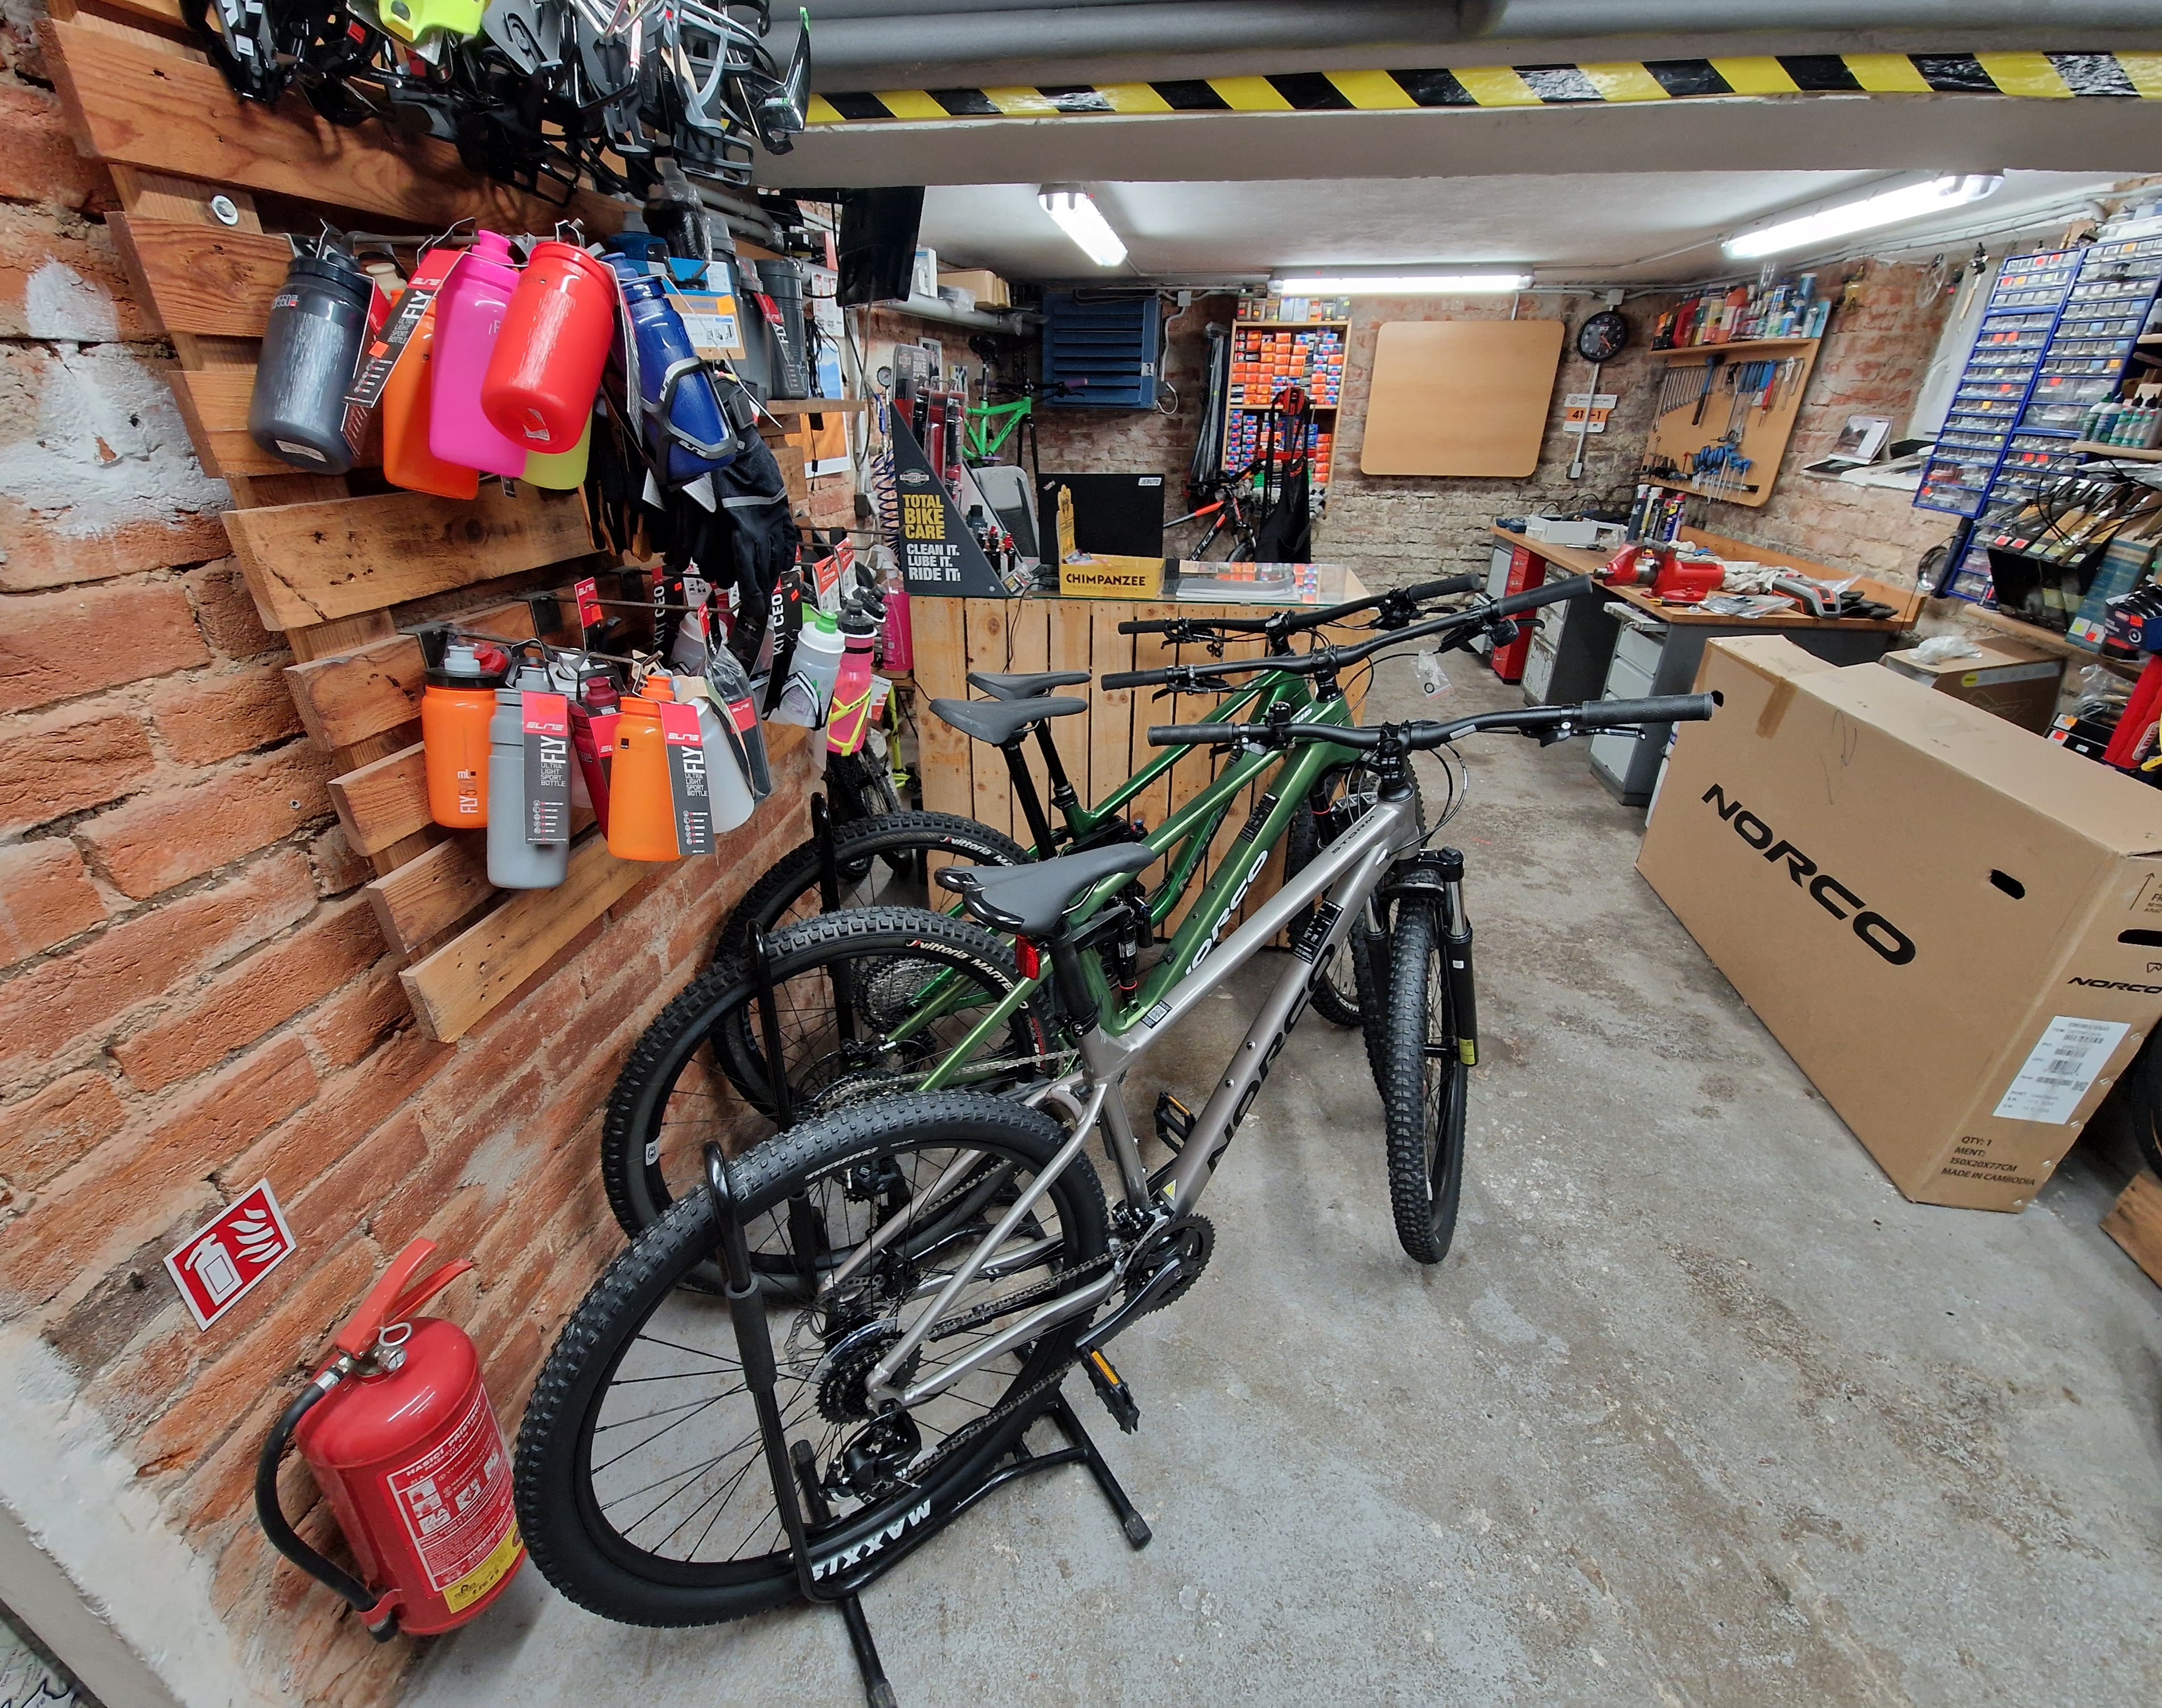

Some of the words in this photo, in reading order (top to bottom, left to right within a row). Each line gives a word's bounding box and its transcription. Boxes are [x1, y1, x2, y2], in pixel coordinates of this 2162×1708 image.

[401, 290, 433, 319] FLY
[387, 336, 408, 344] BOTTLE
[902, 494, 944, 508] TOTAL
[903, 507, 945, 525] BIKE
[905, 524, 946, 540] CARE
[906, 543, 944, 556] CLEAN
[946, 544, 960, 556] IT.
[907, 555, 938, 567] LUBE
[939, 556, 953, 568] IT.
[908, 566, 942, 581] RIDE
[945, 567, 961, 582] IT!
[1066, 573, 1146, 586] CHIMPANZEE
[653, 585, 666, 618] CEO
[771, 593, 785, 627] CEO
[654, 622, 667, 646] KIT
[773, 632, 786, 656] KIT
[540, 735, 566, 764] FLY
[681, 745, 706, 774] FLY
[1331, 815, 1375, 855] STORM
[948, 837, 993, 856] vittoria
[1701, 783, 1916, 966] NORCO
[920, 941, 968, 959] vittoria
[2066, 976, 2162, 995] NORCO
[1961, 1136, 1984, 1145] QTY:
[1954, 1146, 1987, 1157] MENT:
[1949, 1157, 2018, 1172] 150X20X77CM
[1940, 1167, 1971, 1178] MADE
[1971, 1171, 1983, 1180] IN
[1983, 1173, 2036, 1186] CAMBODIA
[812, 1498, 931, 1582] MAXXIS
